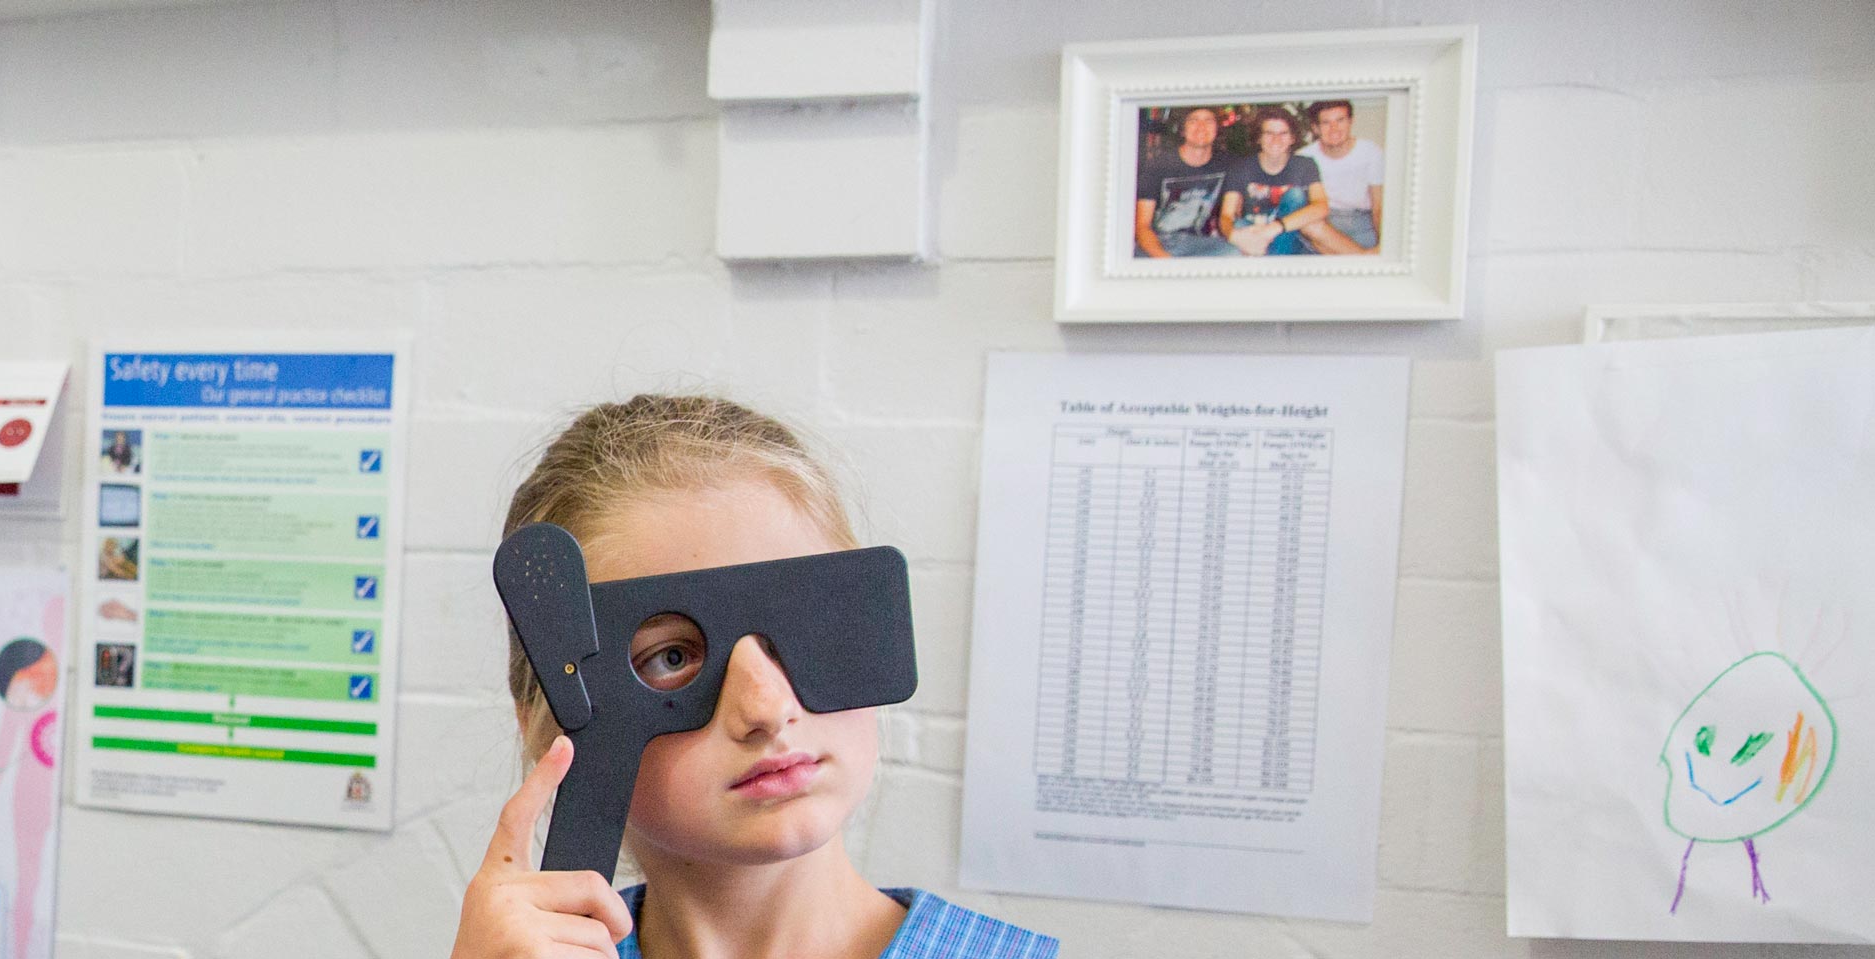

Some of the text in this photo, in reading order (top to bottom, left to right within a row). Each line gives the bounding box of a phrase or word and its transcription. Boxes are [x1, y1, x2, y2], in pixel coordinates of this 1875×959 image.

[109, 357, 279, 388] Safety every time
[1059, 401, 1096, 414] Table
[1099, 402, 1115, 414] of
[1118, 402, 1191, 418] Acceptable
